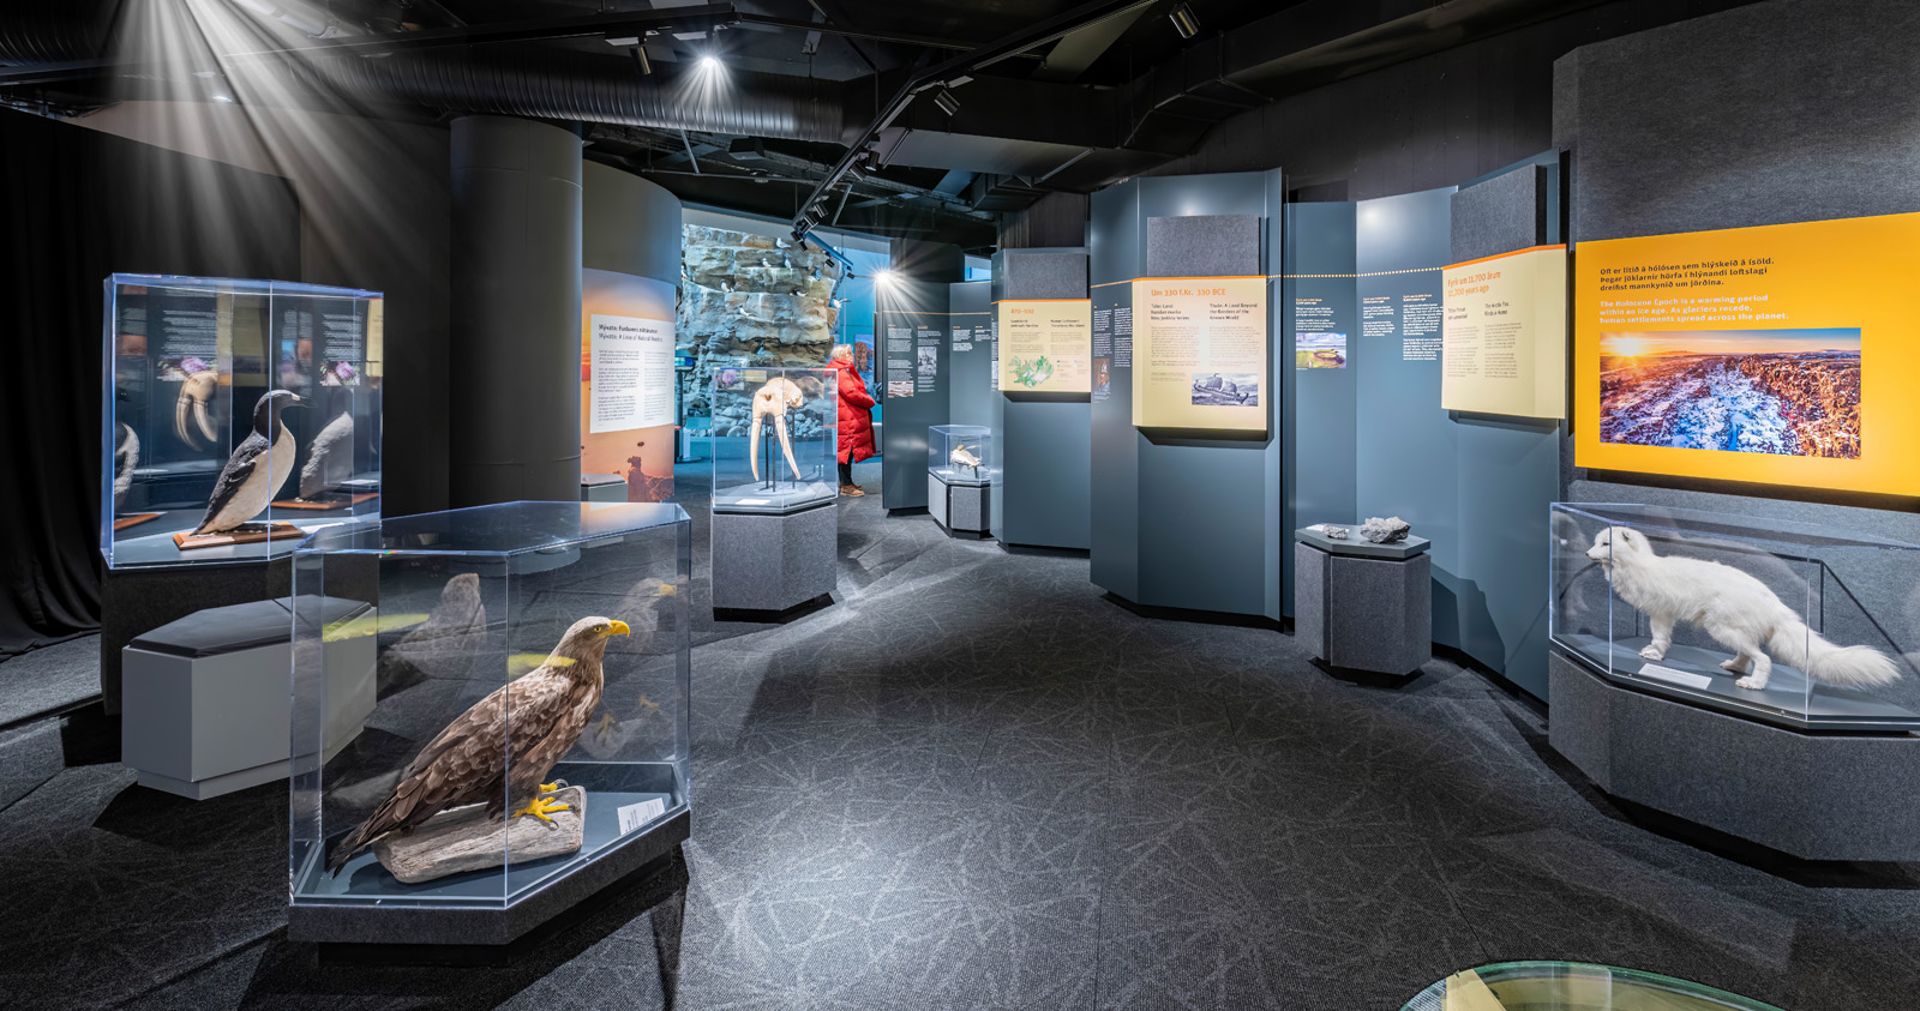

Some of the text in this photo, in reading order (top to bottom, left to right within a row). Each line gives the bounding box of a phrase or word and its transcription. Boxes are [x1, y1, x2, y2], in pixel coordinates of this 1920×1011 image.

[1212, 288, 1226, 296] BCE
[1654, 298, 1678, 306] Epoch
[1698, 296, 1734, 304] warming
[1738, 294, 1768, 303] period
